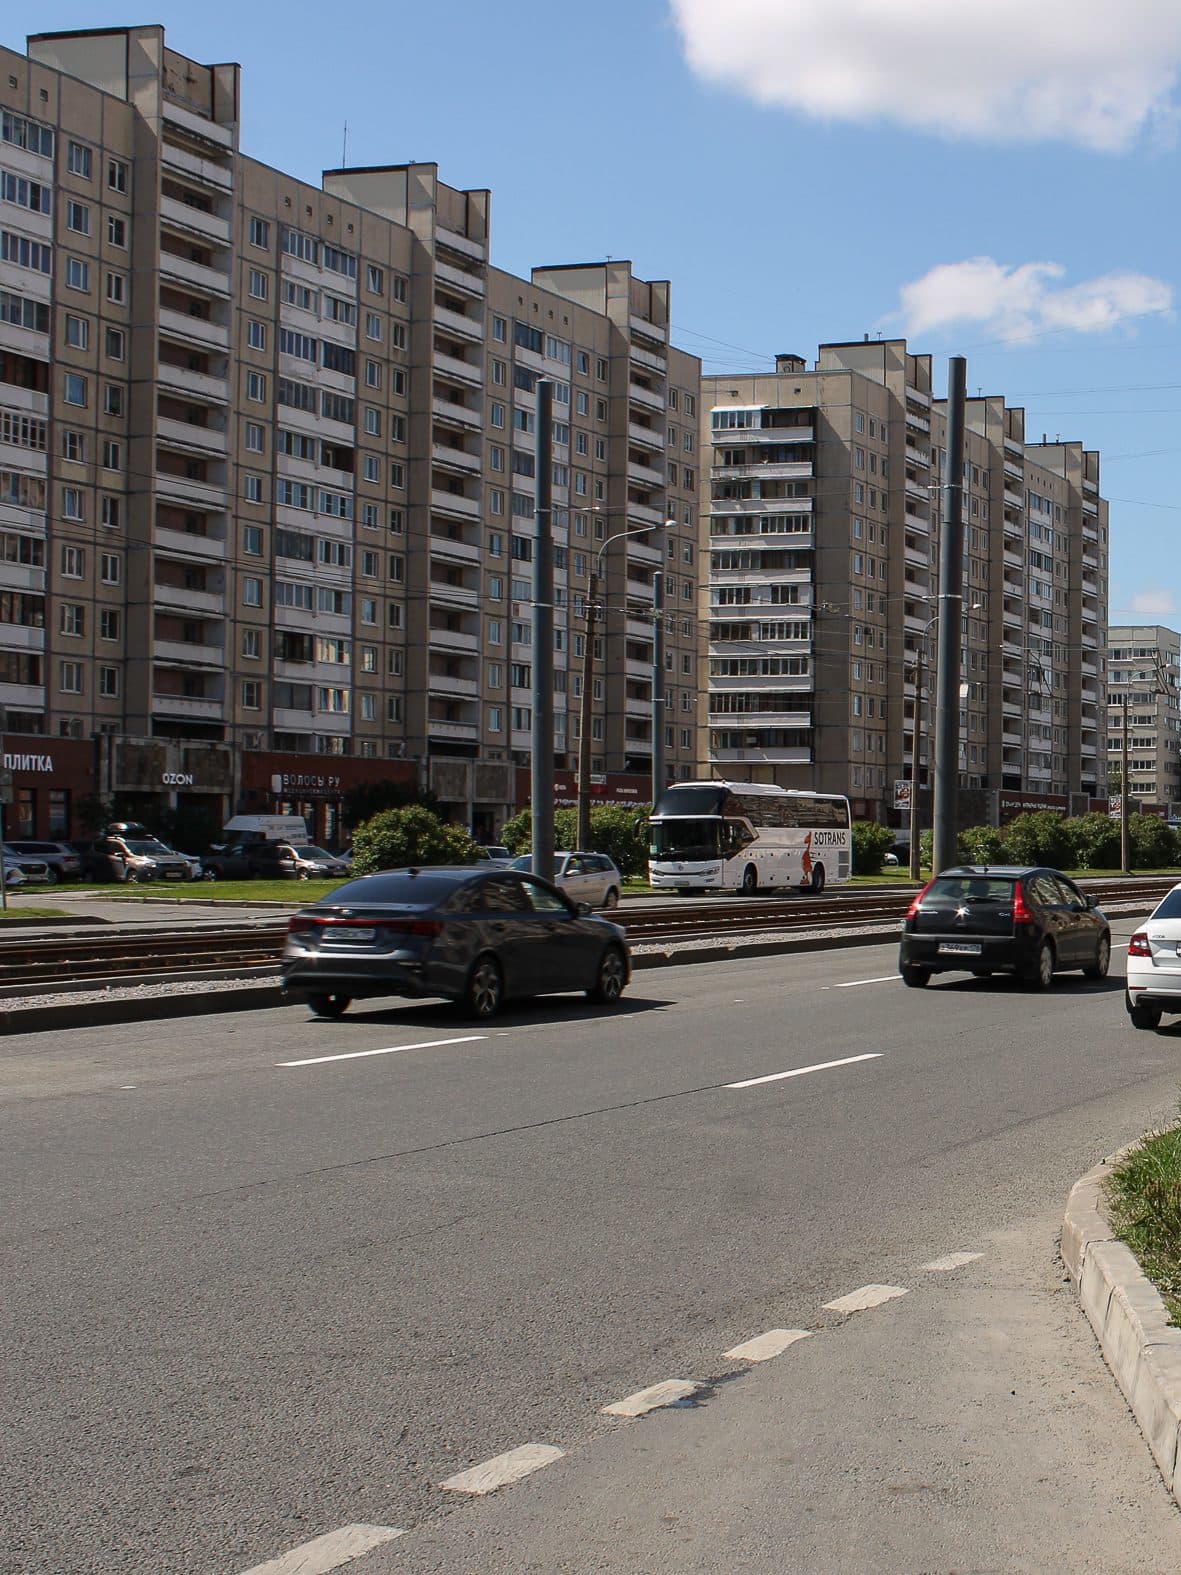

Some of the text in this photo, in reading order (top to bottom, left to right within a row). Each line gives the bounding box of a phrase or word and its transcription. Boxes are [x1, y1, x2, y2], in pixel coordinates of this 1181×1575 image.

[3, 753, 53, 772] ПЛИТКА
[162, 773, 193, 785] OZON
[283, 774, 325, 787] ВОЛОСЫ
[814, 831, 846, 846] SOTRANS
